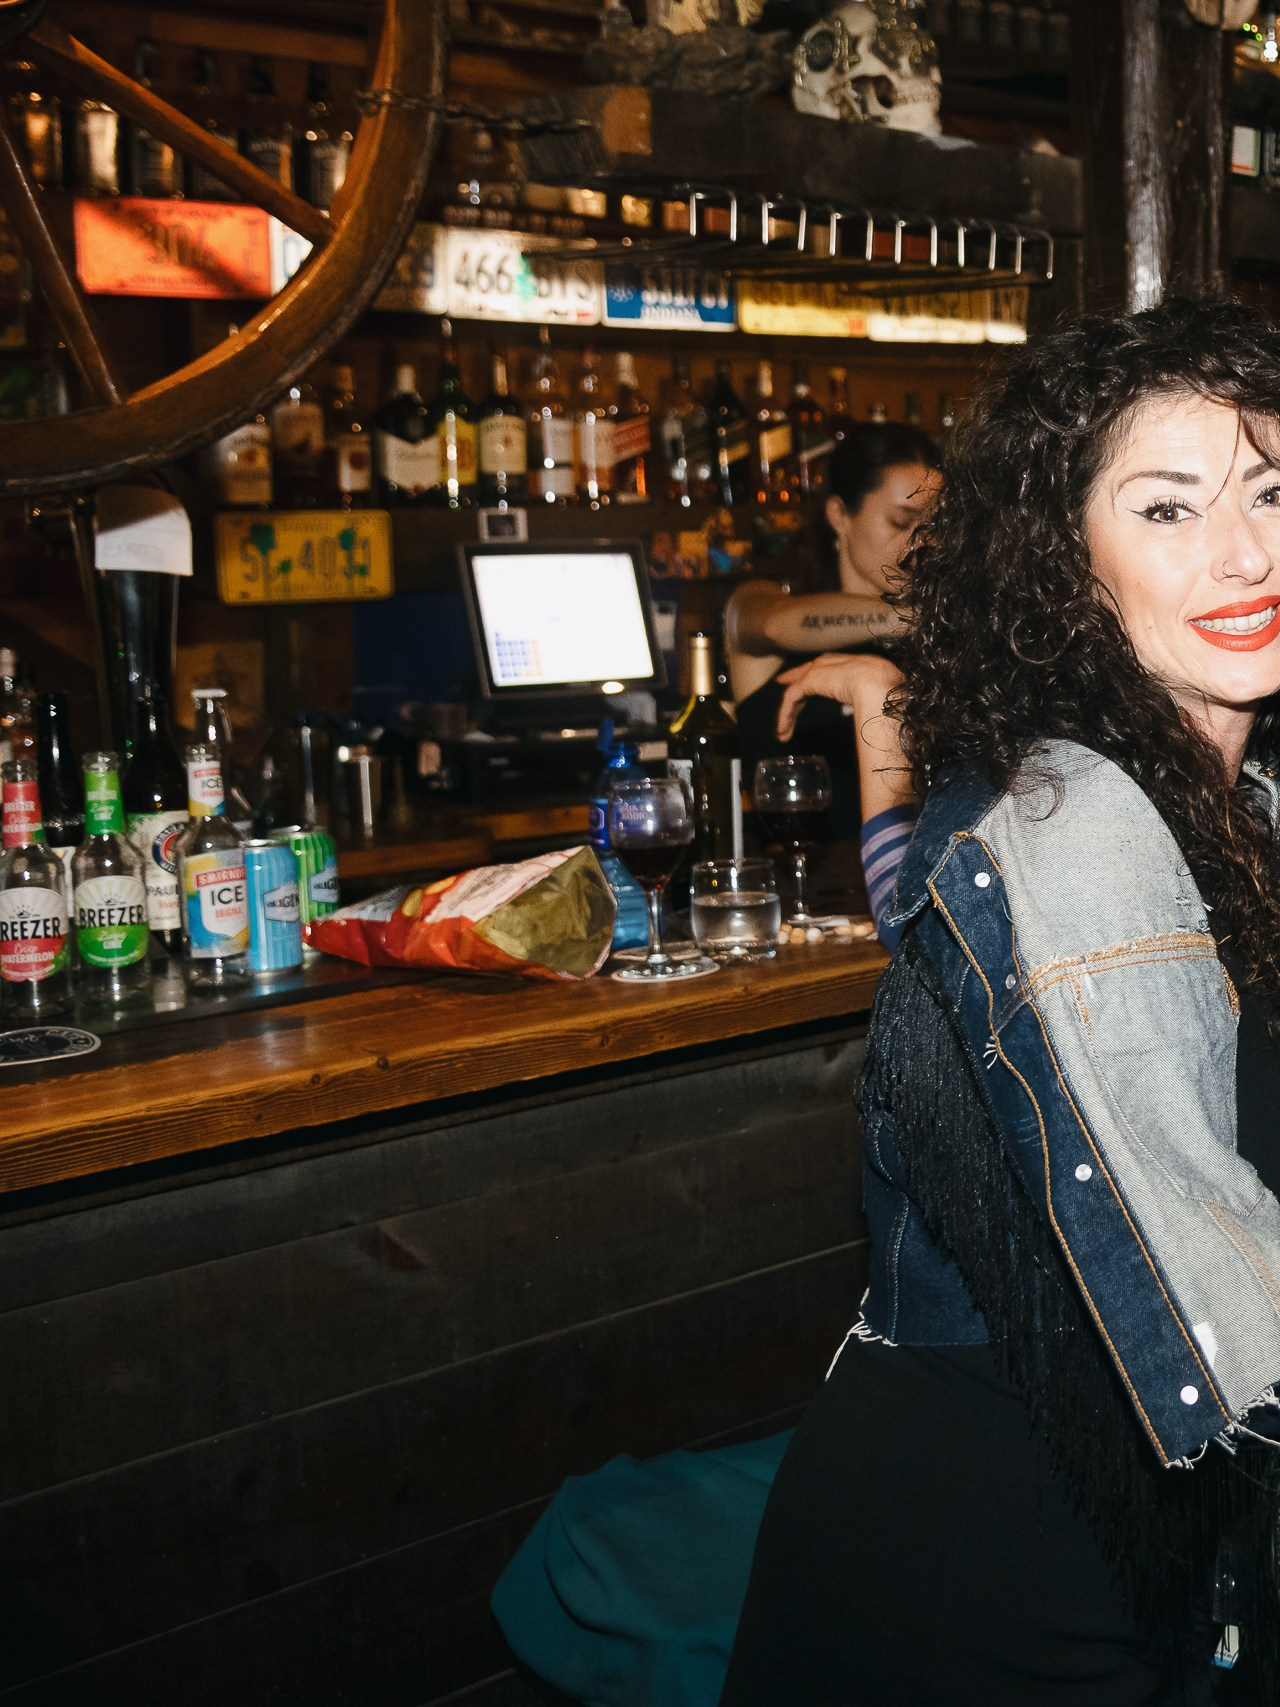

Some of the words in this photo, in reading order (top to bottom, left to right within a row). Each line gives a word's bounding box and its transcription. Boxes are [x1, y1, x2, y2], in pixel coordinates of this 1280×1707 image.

[454, 251, 514, 294] 466
[210, 886, 245, 906] ICE
[0, 916, 61, 941] REEZER
[79, 904, 144, 929] BREEZER
